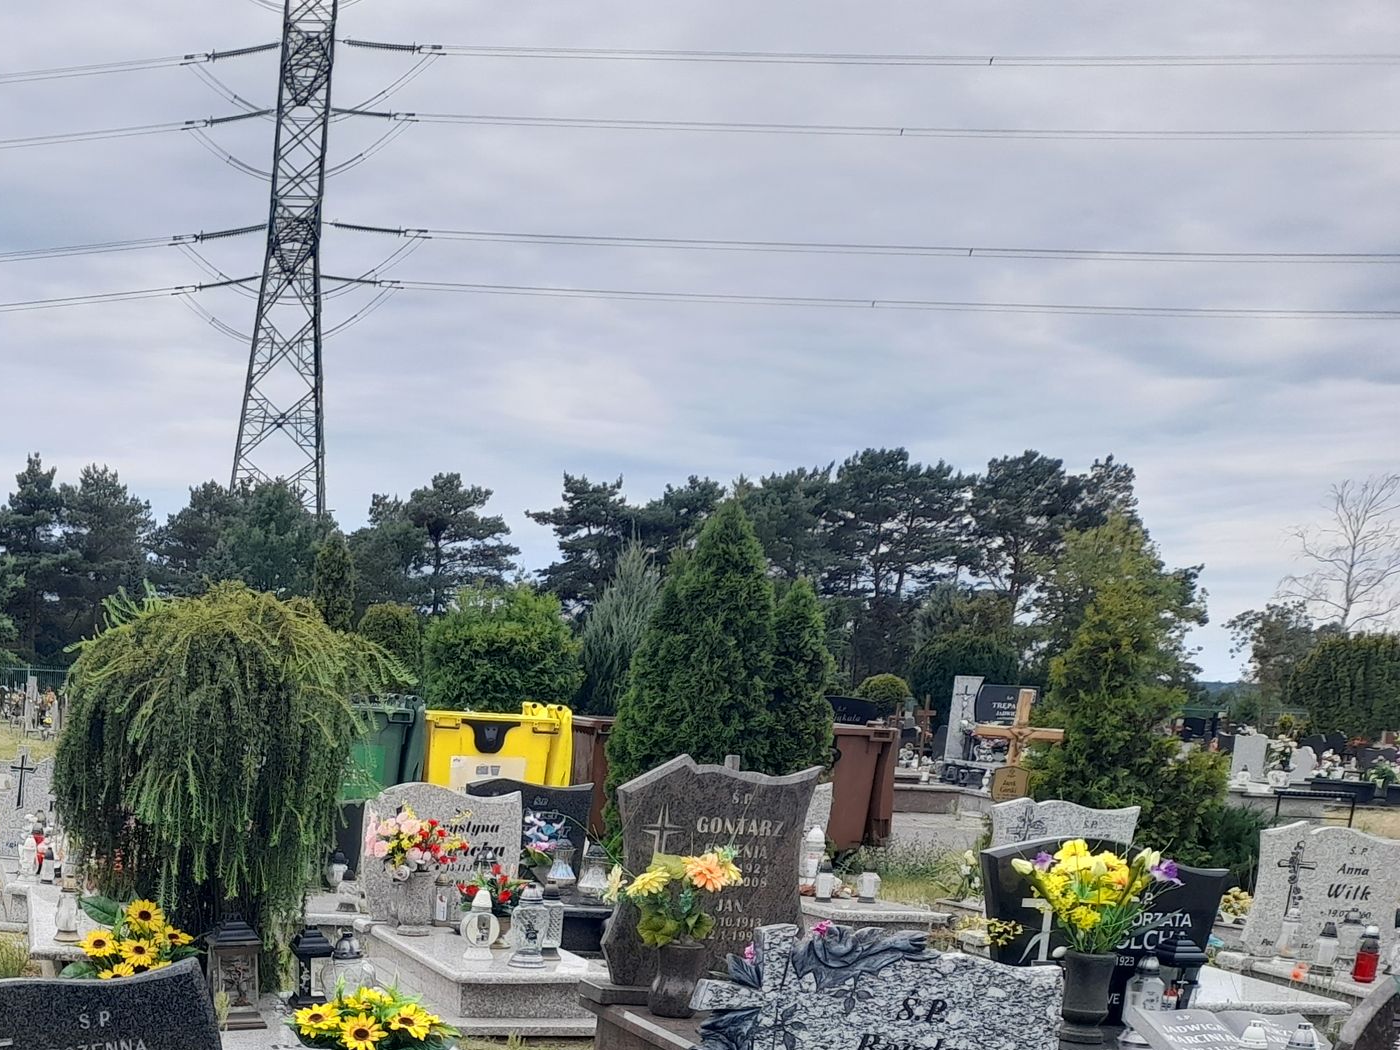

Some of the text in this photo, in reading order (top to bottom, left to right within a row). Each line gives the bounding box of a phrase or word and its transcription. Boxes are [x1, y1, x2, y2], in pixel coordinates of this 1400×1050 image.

[442, 821, 501, 837] rystyna
[696, 815, 785, 837] GONTARZ
[1336, 863, 1370, 876] Anna
[1327, 883, 1372, 901] Wilk
[715, 898, 744, 913] JAN
[1163, 1021, 1228, 1034] JADWIGA
